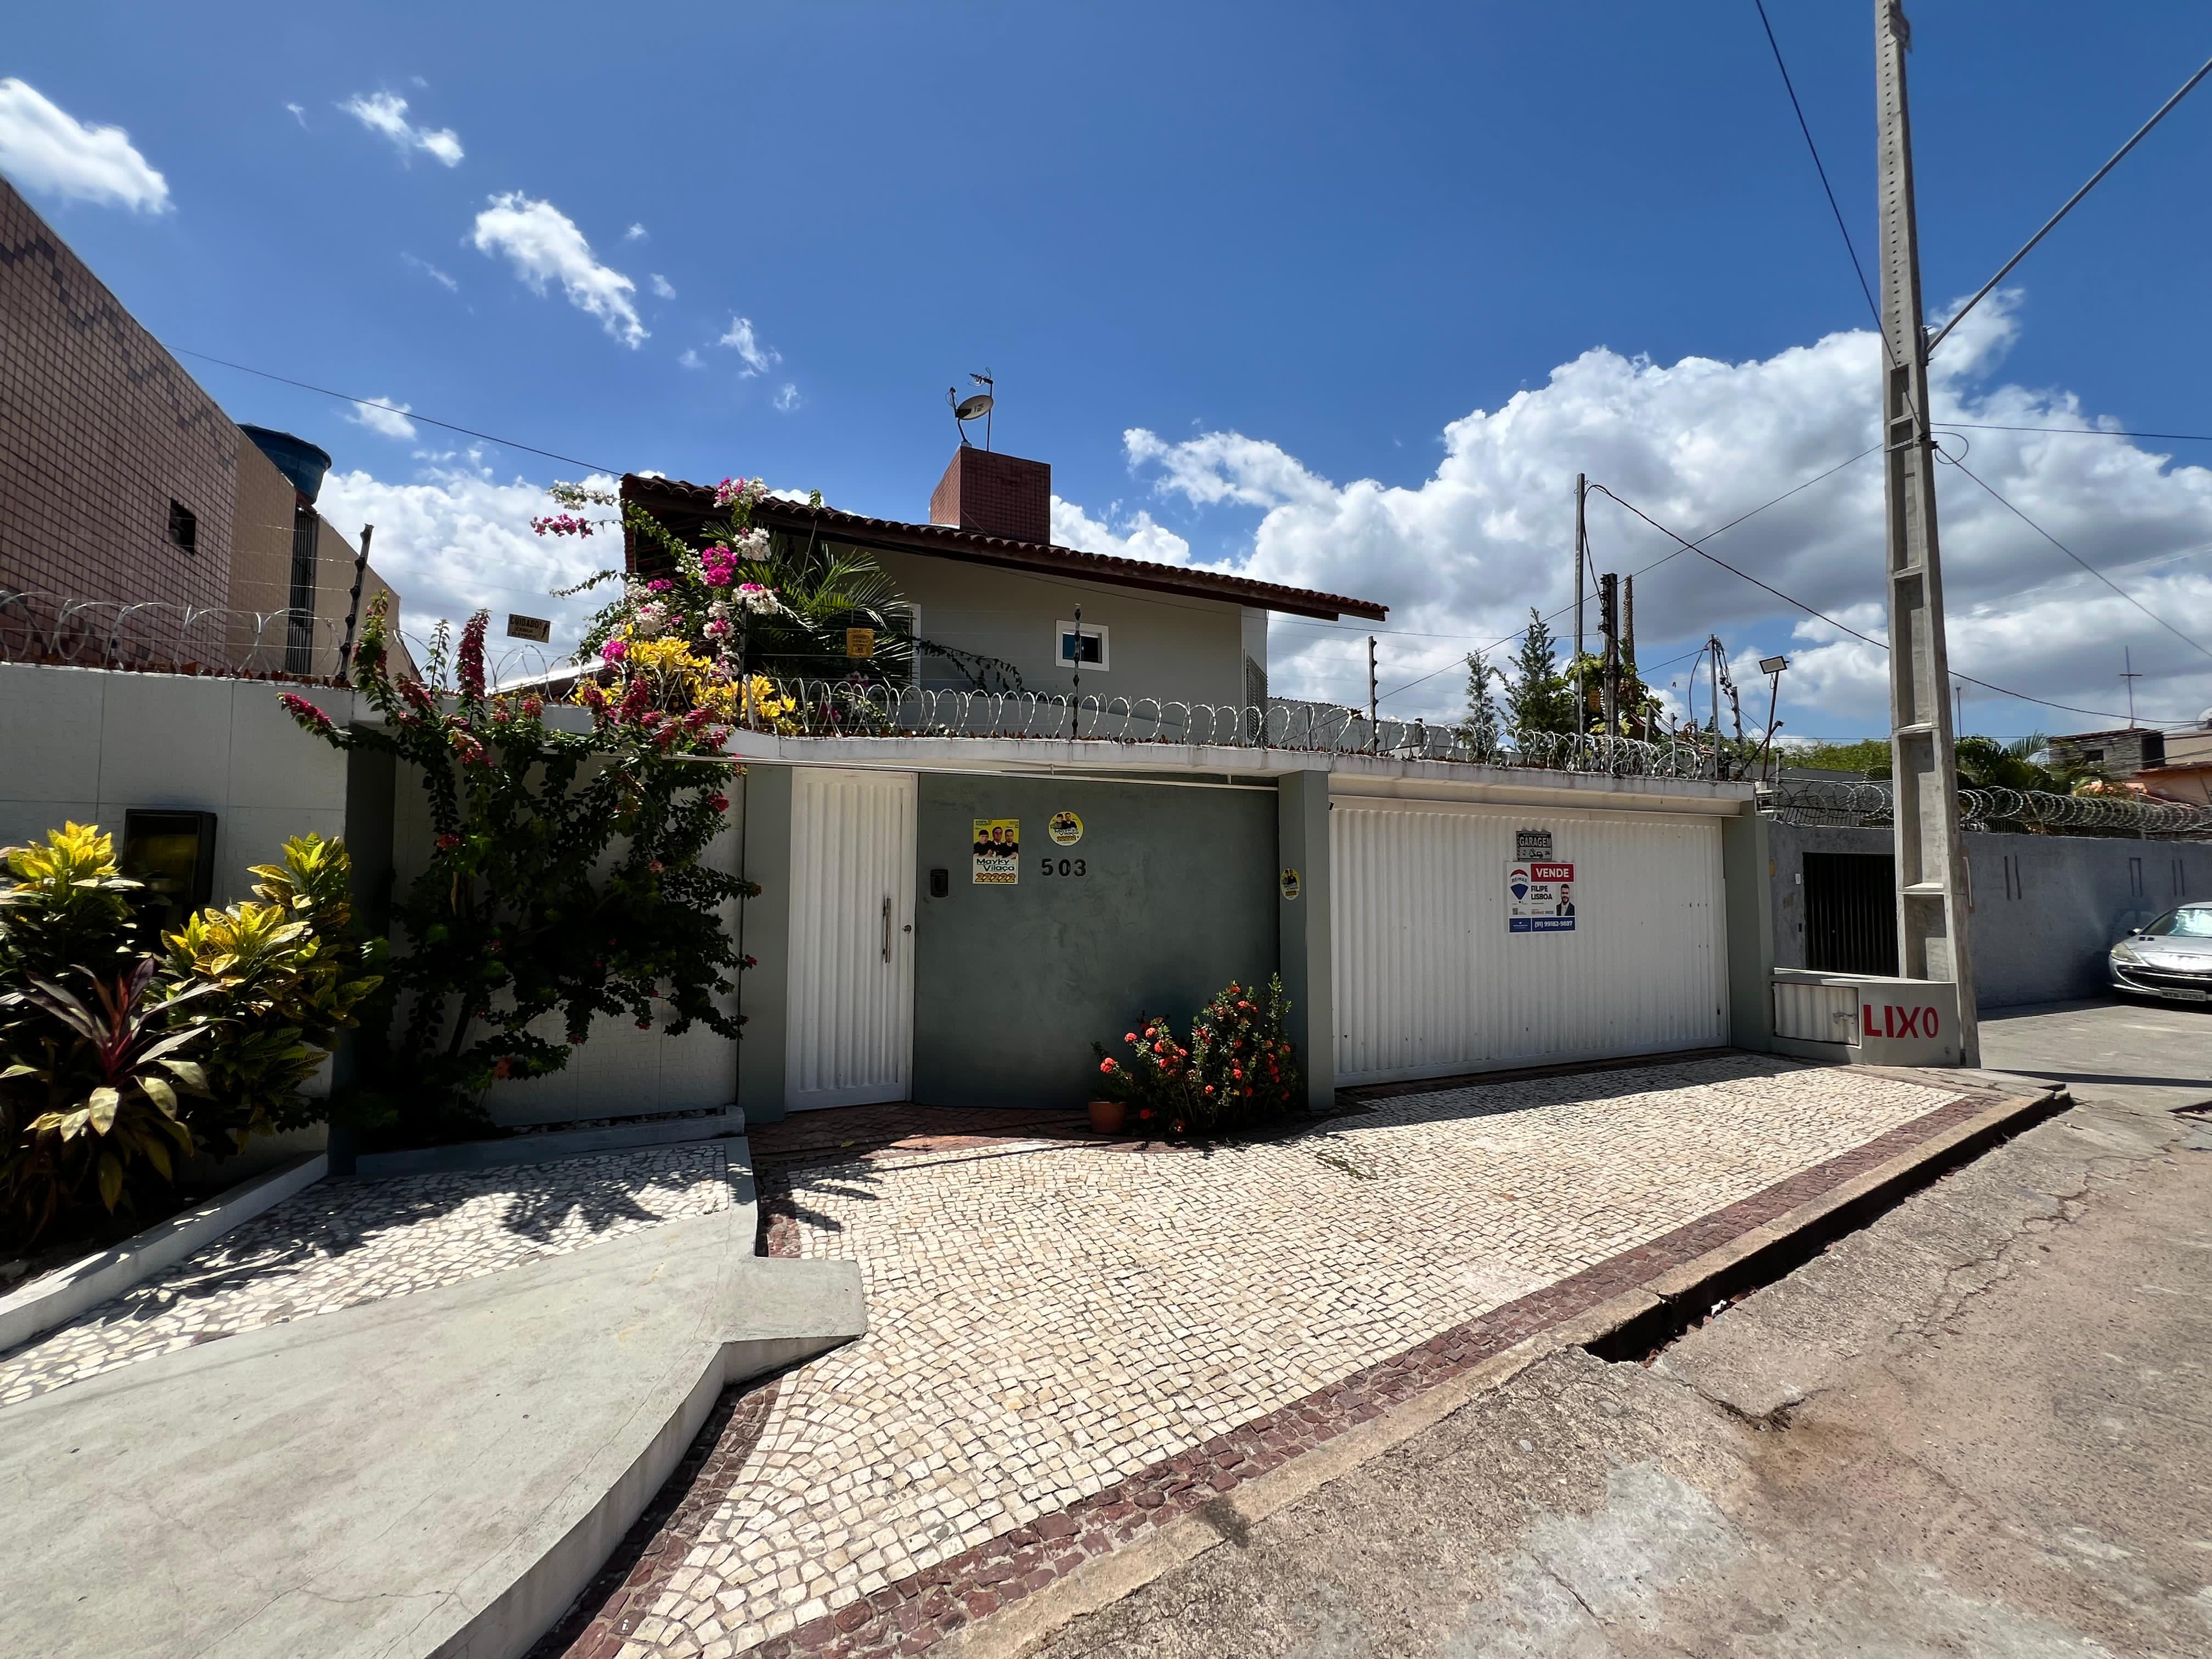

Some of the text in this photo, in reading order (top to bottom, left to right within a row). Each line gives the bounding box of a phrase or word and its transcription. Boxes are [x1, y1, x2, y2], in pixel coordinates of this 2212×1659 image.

[1519, 836, 1551, 847] GARAGEM
[1041, 858, 1087, 877] 503
[1536, 868, 1569, 878] VENDE
[975, 872, 1016, 883] 22222
[1863, 1005, 1939, 1039] LIXO
